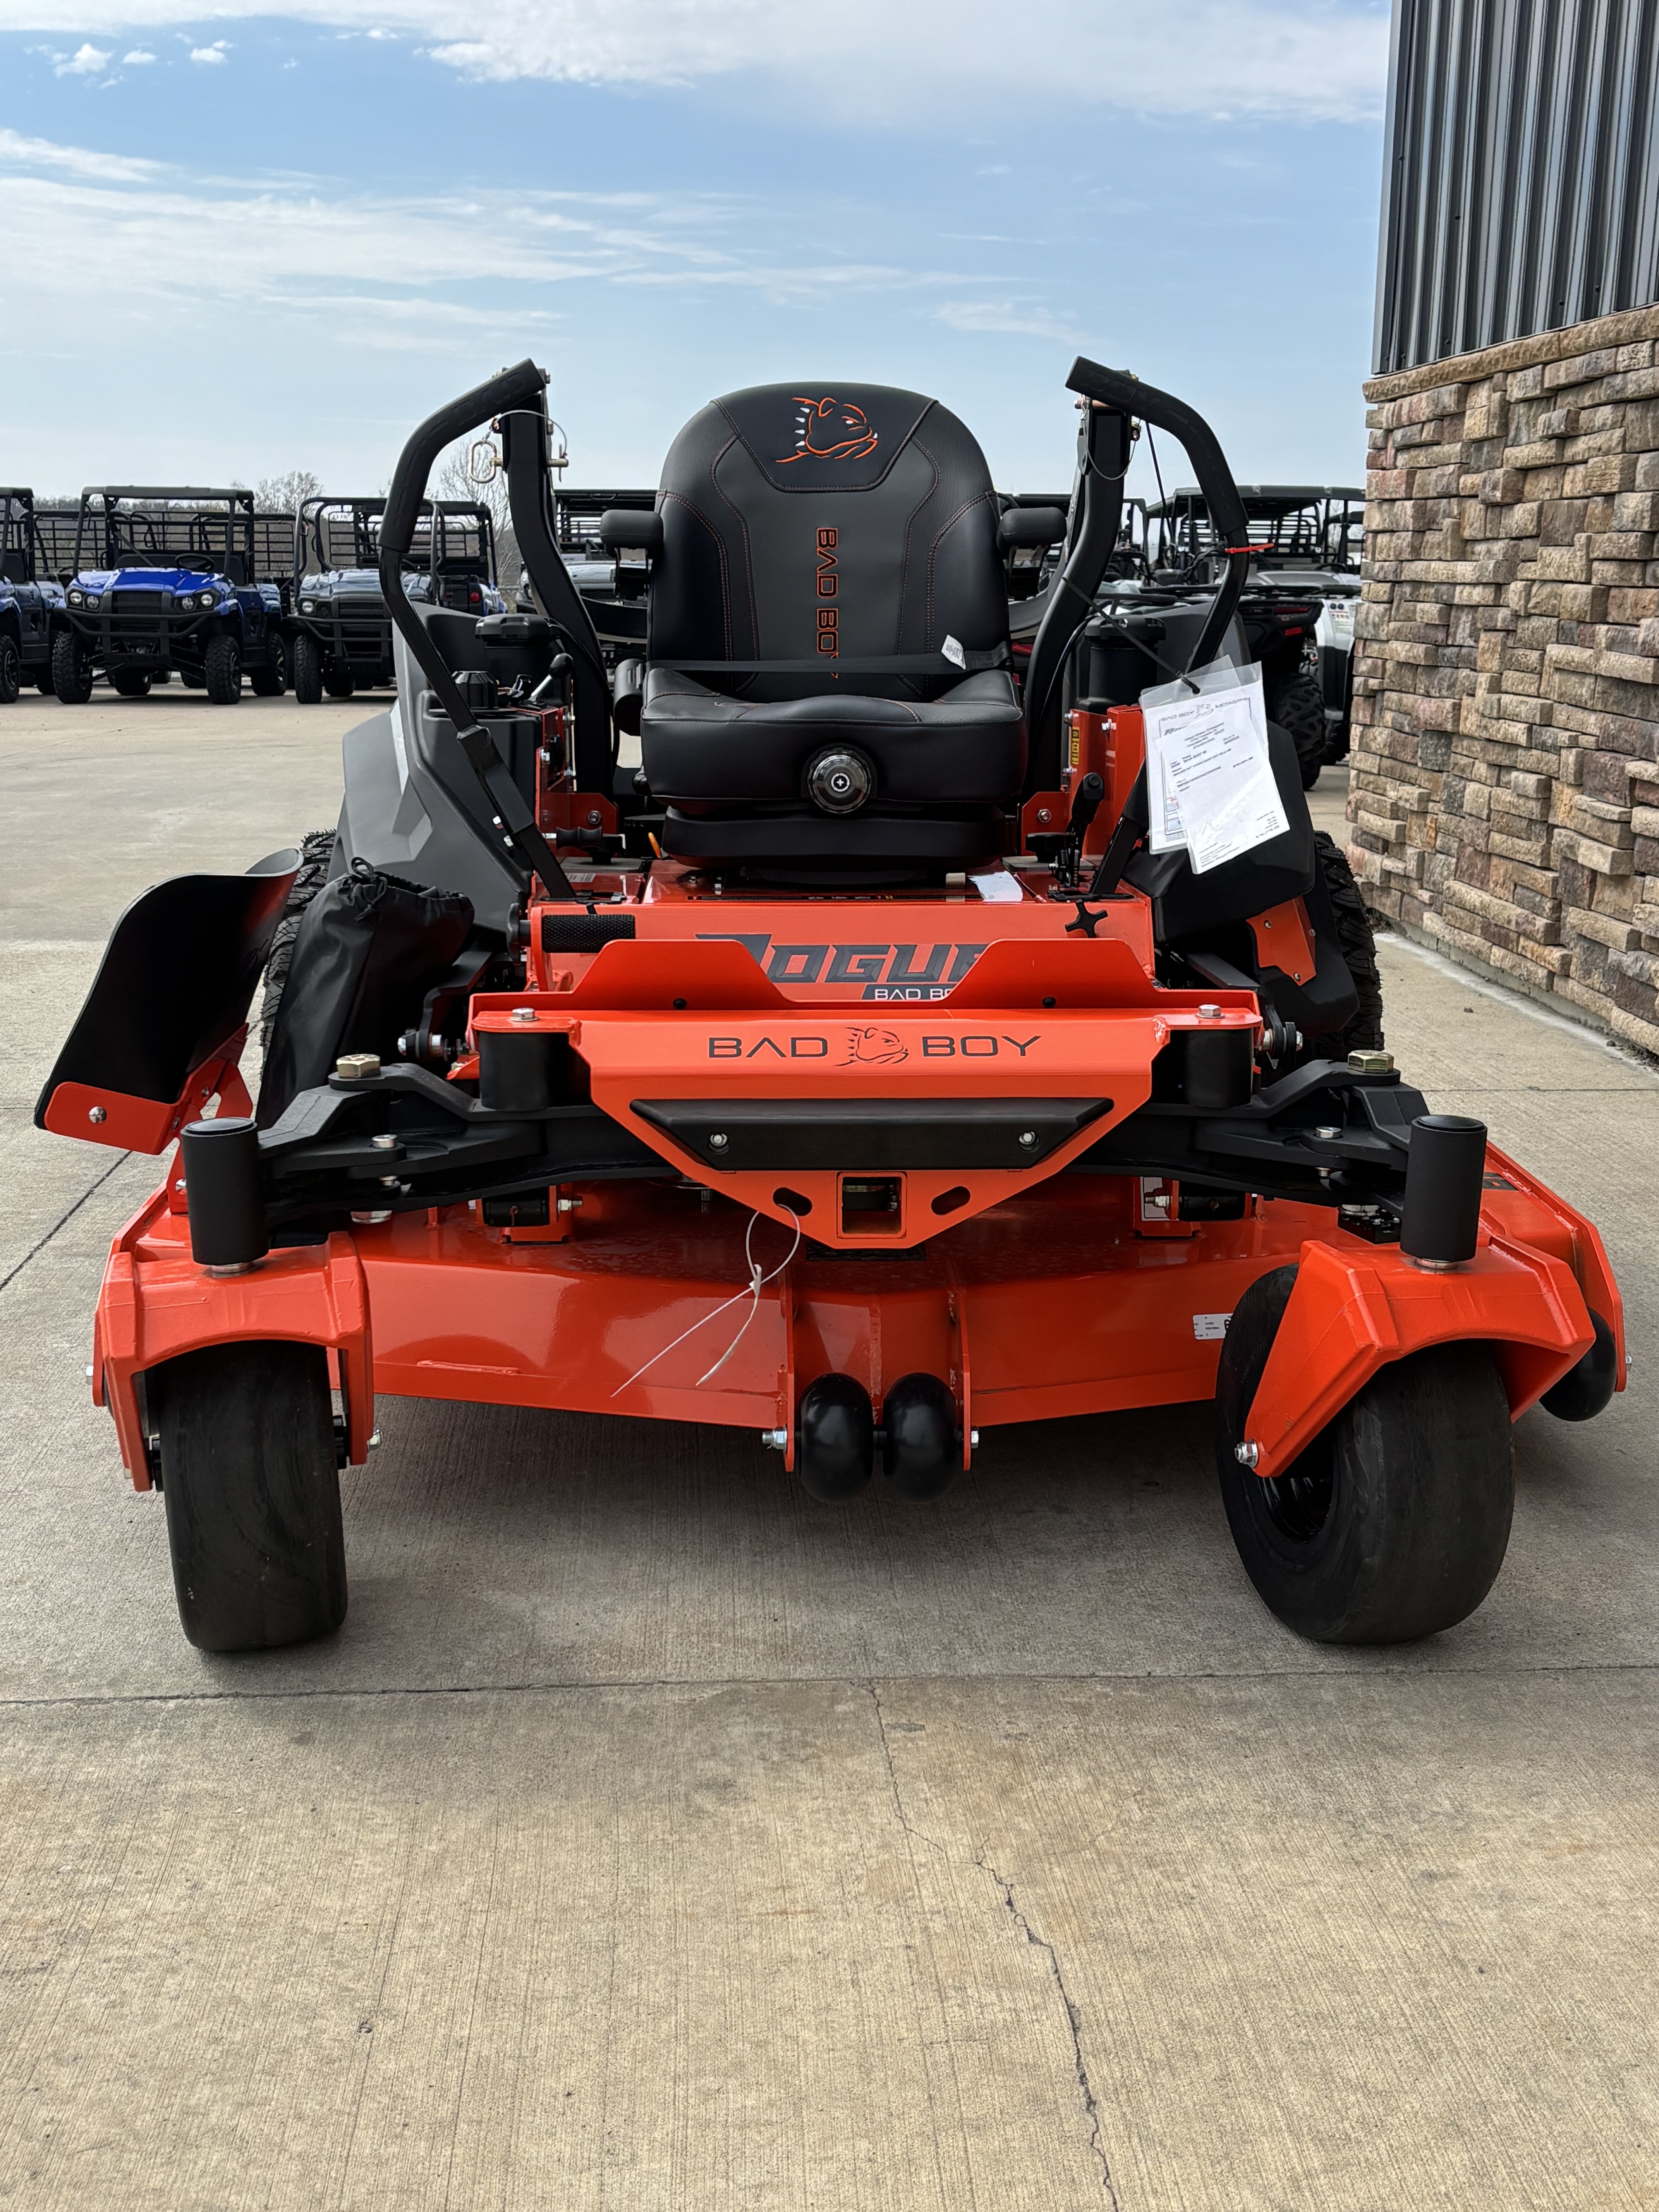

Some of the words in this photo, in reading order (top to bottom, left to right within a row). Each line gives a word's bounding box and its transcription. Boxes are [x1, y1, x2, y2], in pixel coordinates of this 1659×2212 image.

[816, 528, 838, 598] BAD
[875, 988, 921, 1000] BAD
[709, 1037, 828, 1058] BAD
[922, 1036, 1041, 1057] BOY
